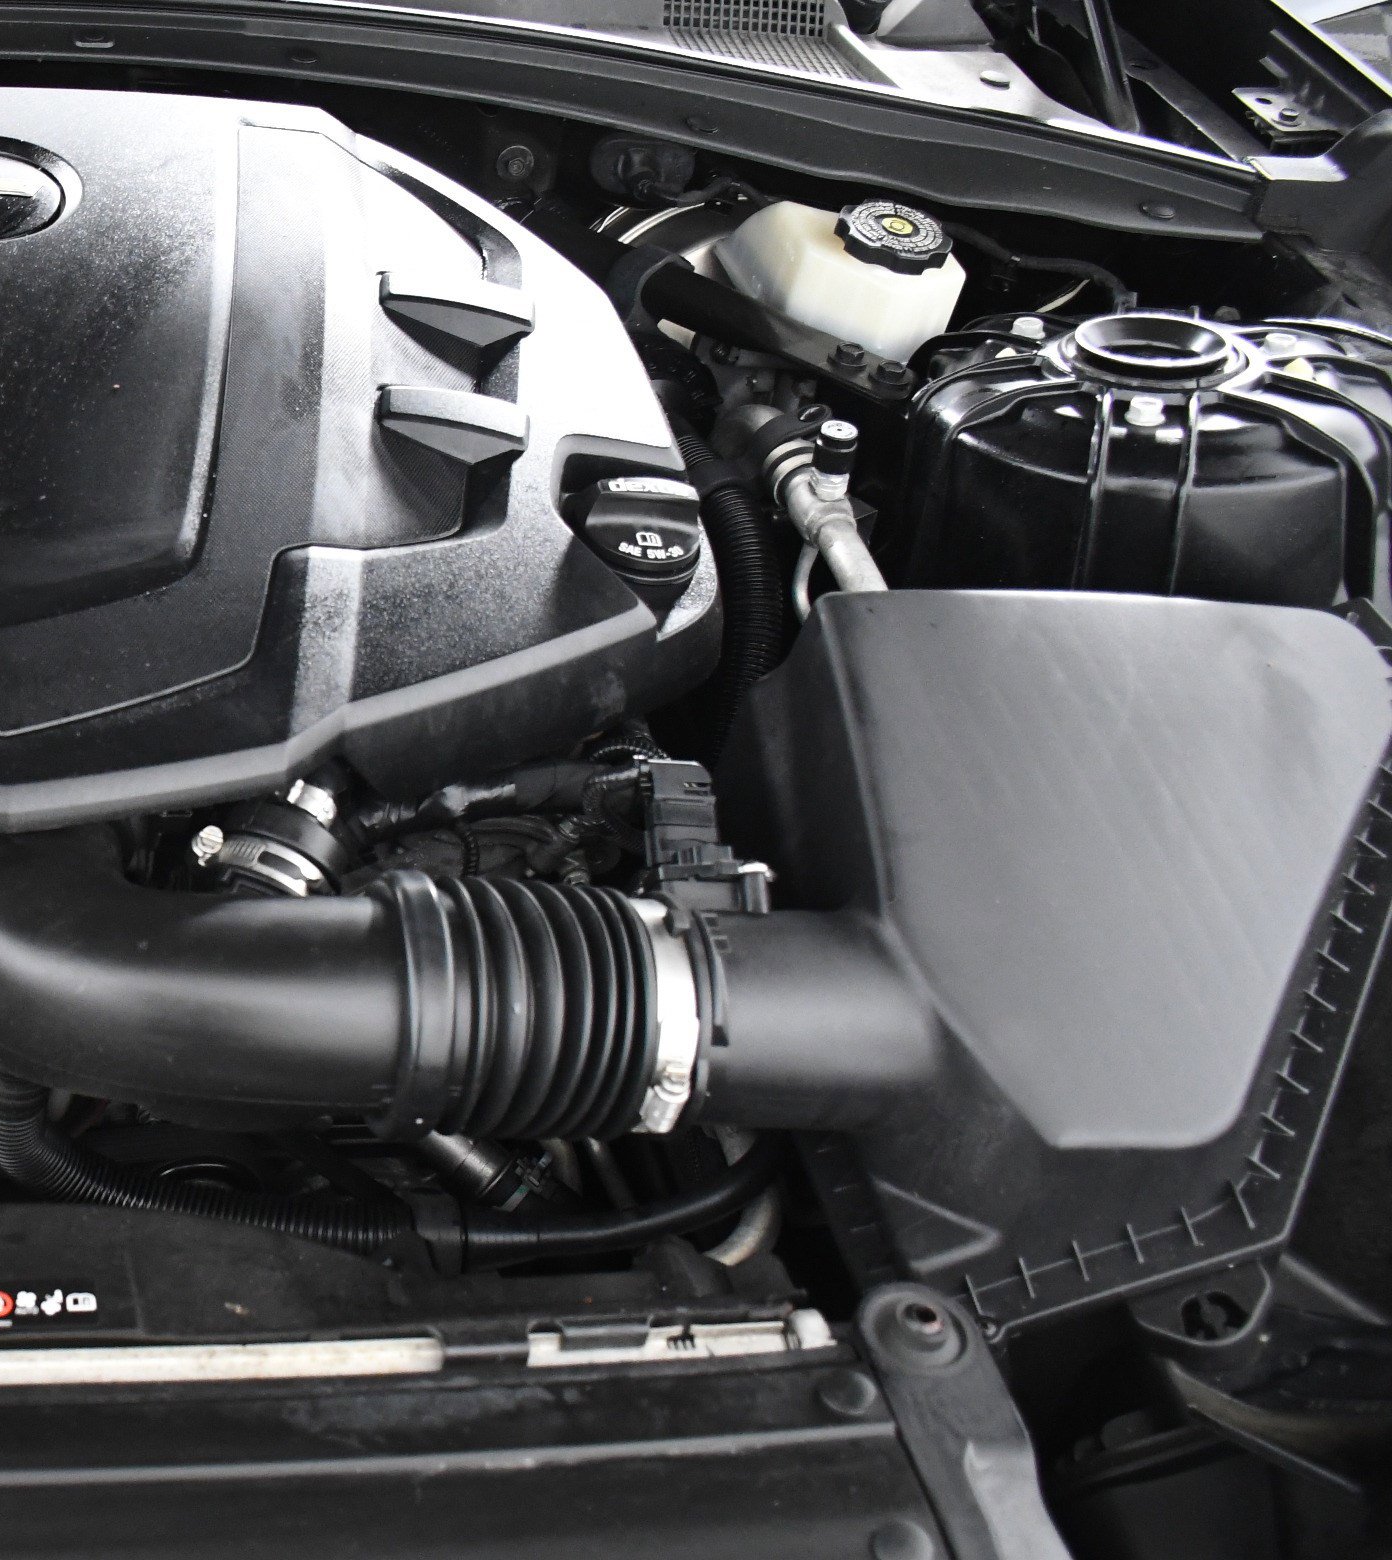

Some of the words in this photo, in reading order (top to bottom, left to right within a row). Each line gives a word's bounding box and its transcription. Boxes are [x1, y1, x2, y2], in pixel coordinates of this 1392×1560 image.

[608, 477, 690, 497] dex
[618, 542, 642, 557] SAE
[646, 545, 684, 559] 5W-30
